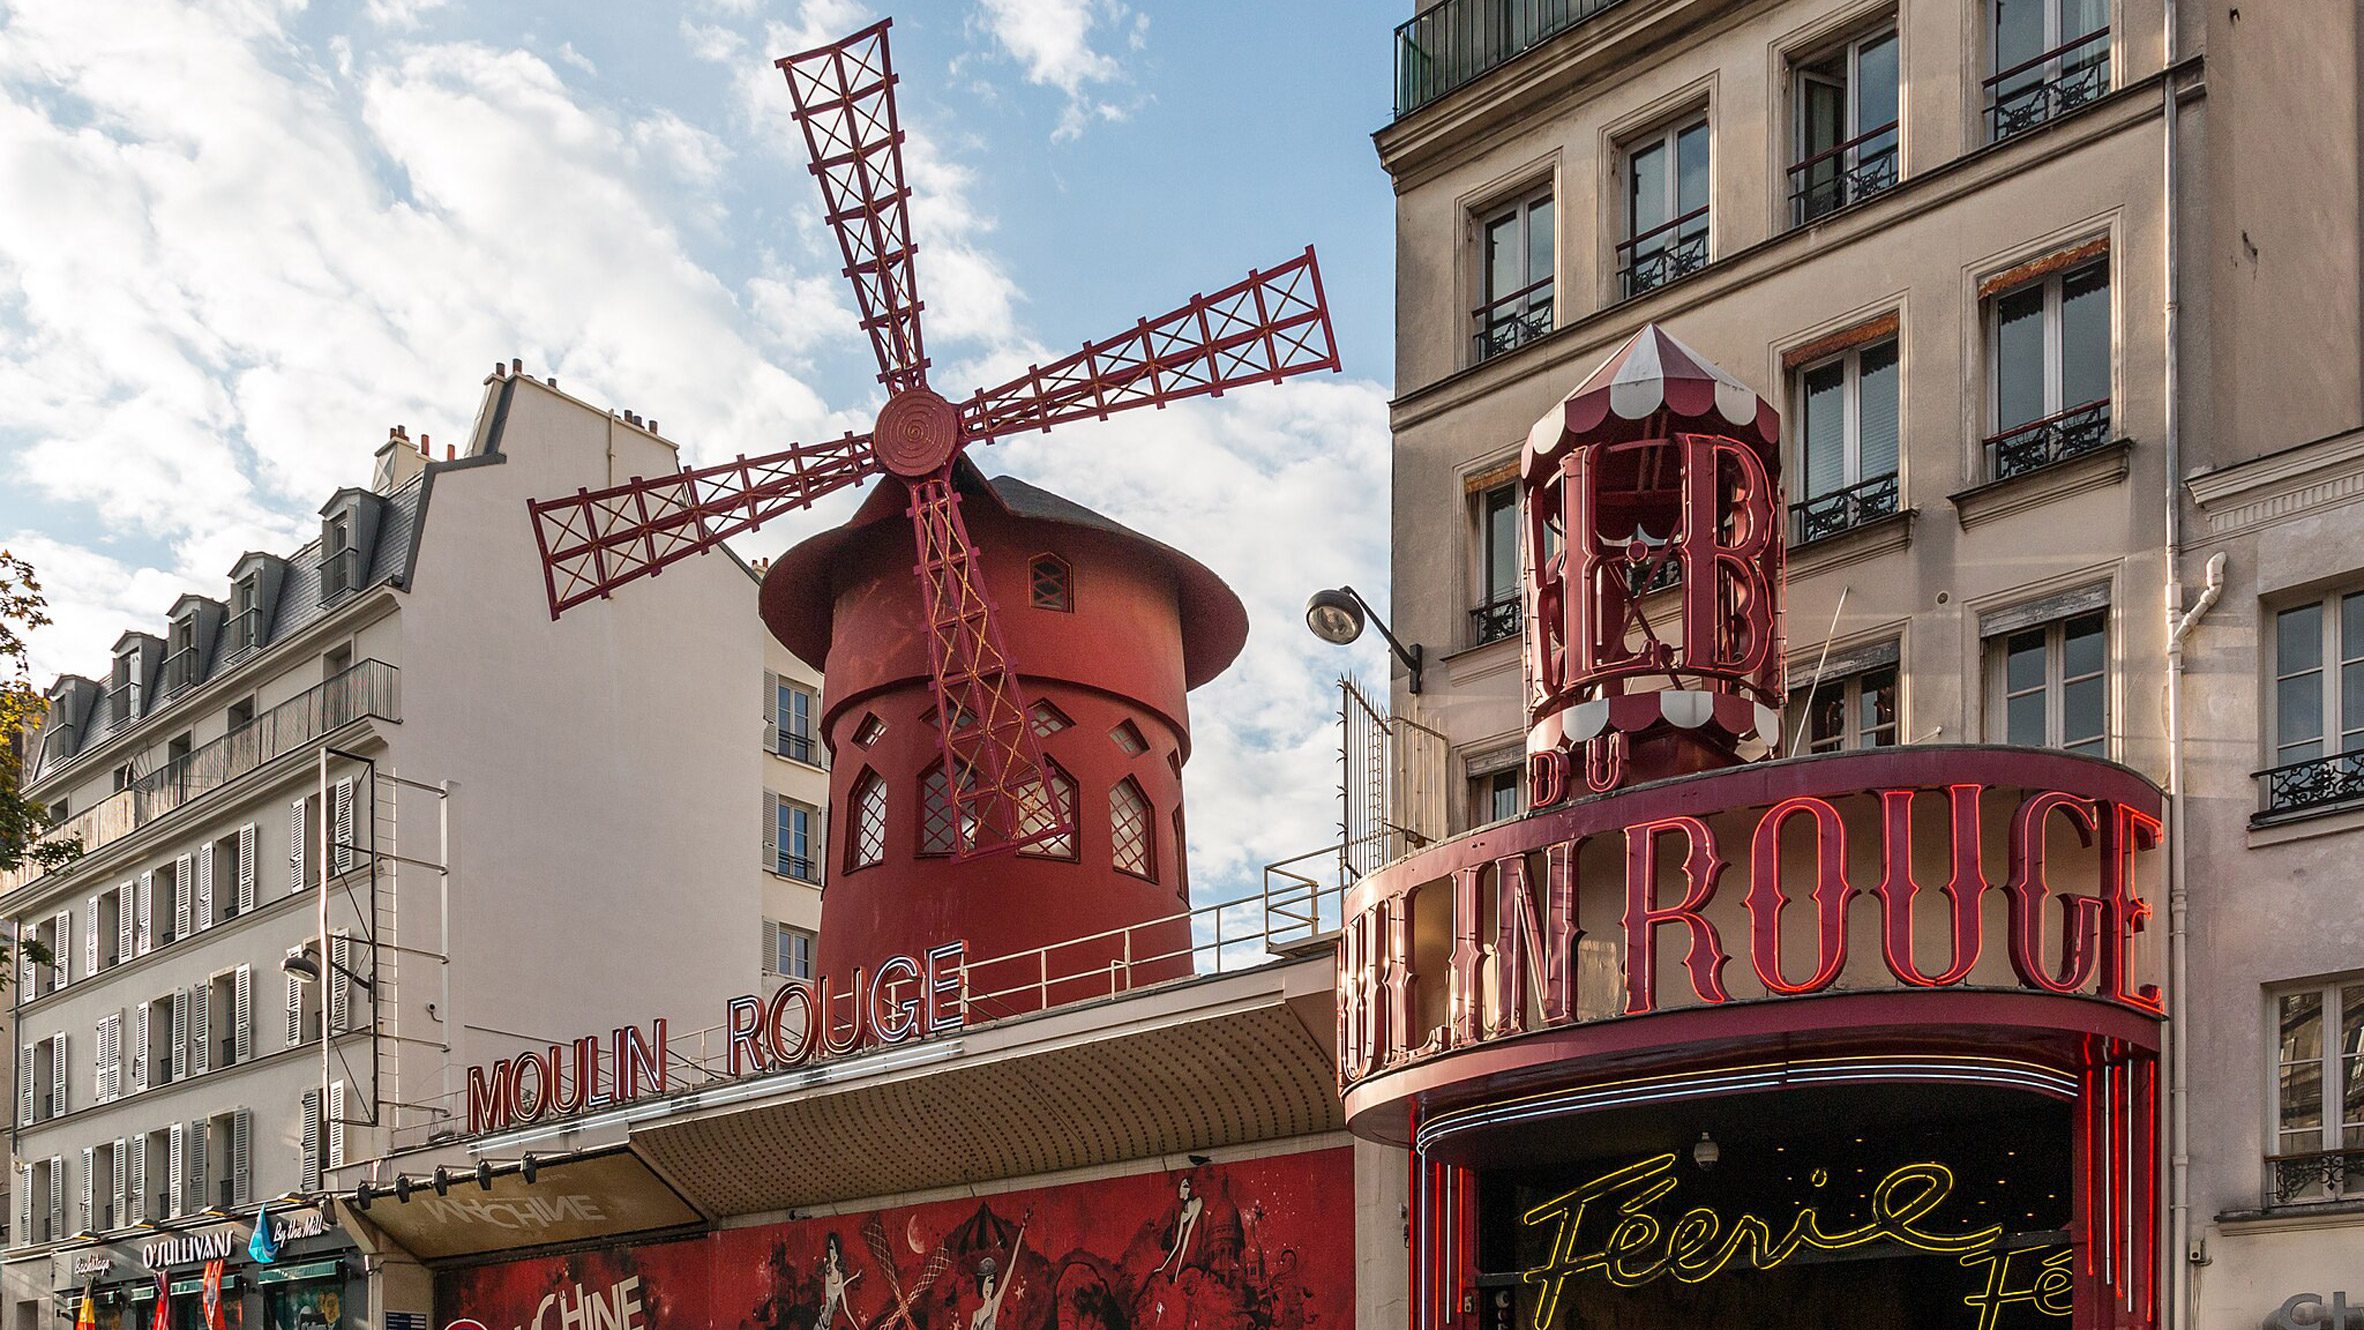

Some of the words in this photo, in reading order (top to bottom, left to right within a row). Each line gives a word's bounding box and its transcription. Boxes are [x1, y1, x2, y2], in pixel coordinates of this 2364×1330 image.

[1527, 732, 1629, 809] DU
[1622, 782, 2166, 1015] ROUGE
[467, 1017, 667, 1133] MOULIN
[726, 939, 969, 1077] ROUGE
[143, 1231, 233, 1268] O'SULLIVANS
[274, 1221, 287, 1248] By
[287, 1219, 302, 1240] the
[302, 1214, 323, 1238] Mill
[1523, 1152, 2003, 1330] Féerie
